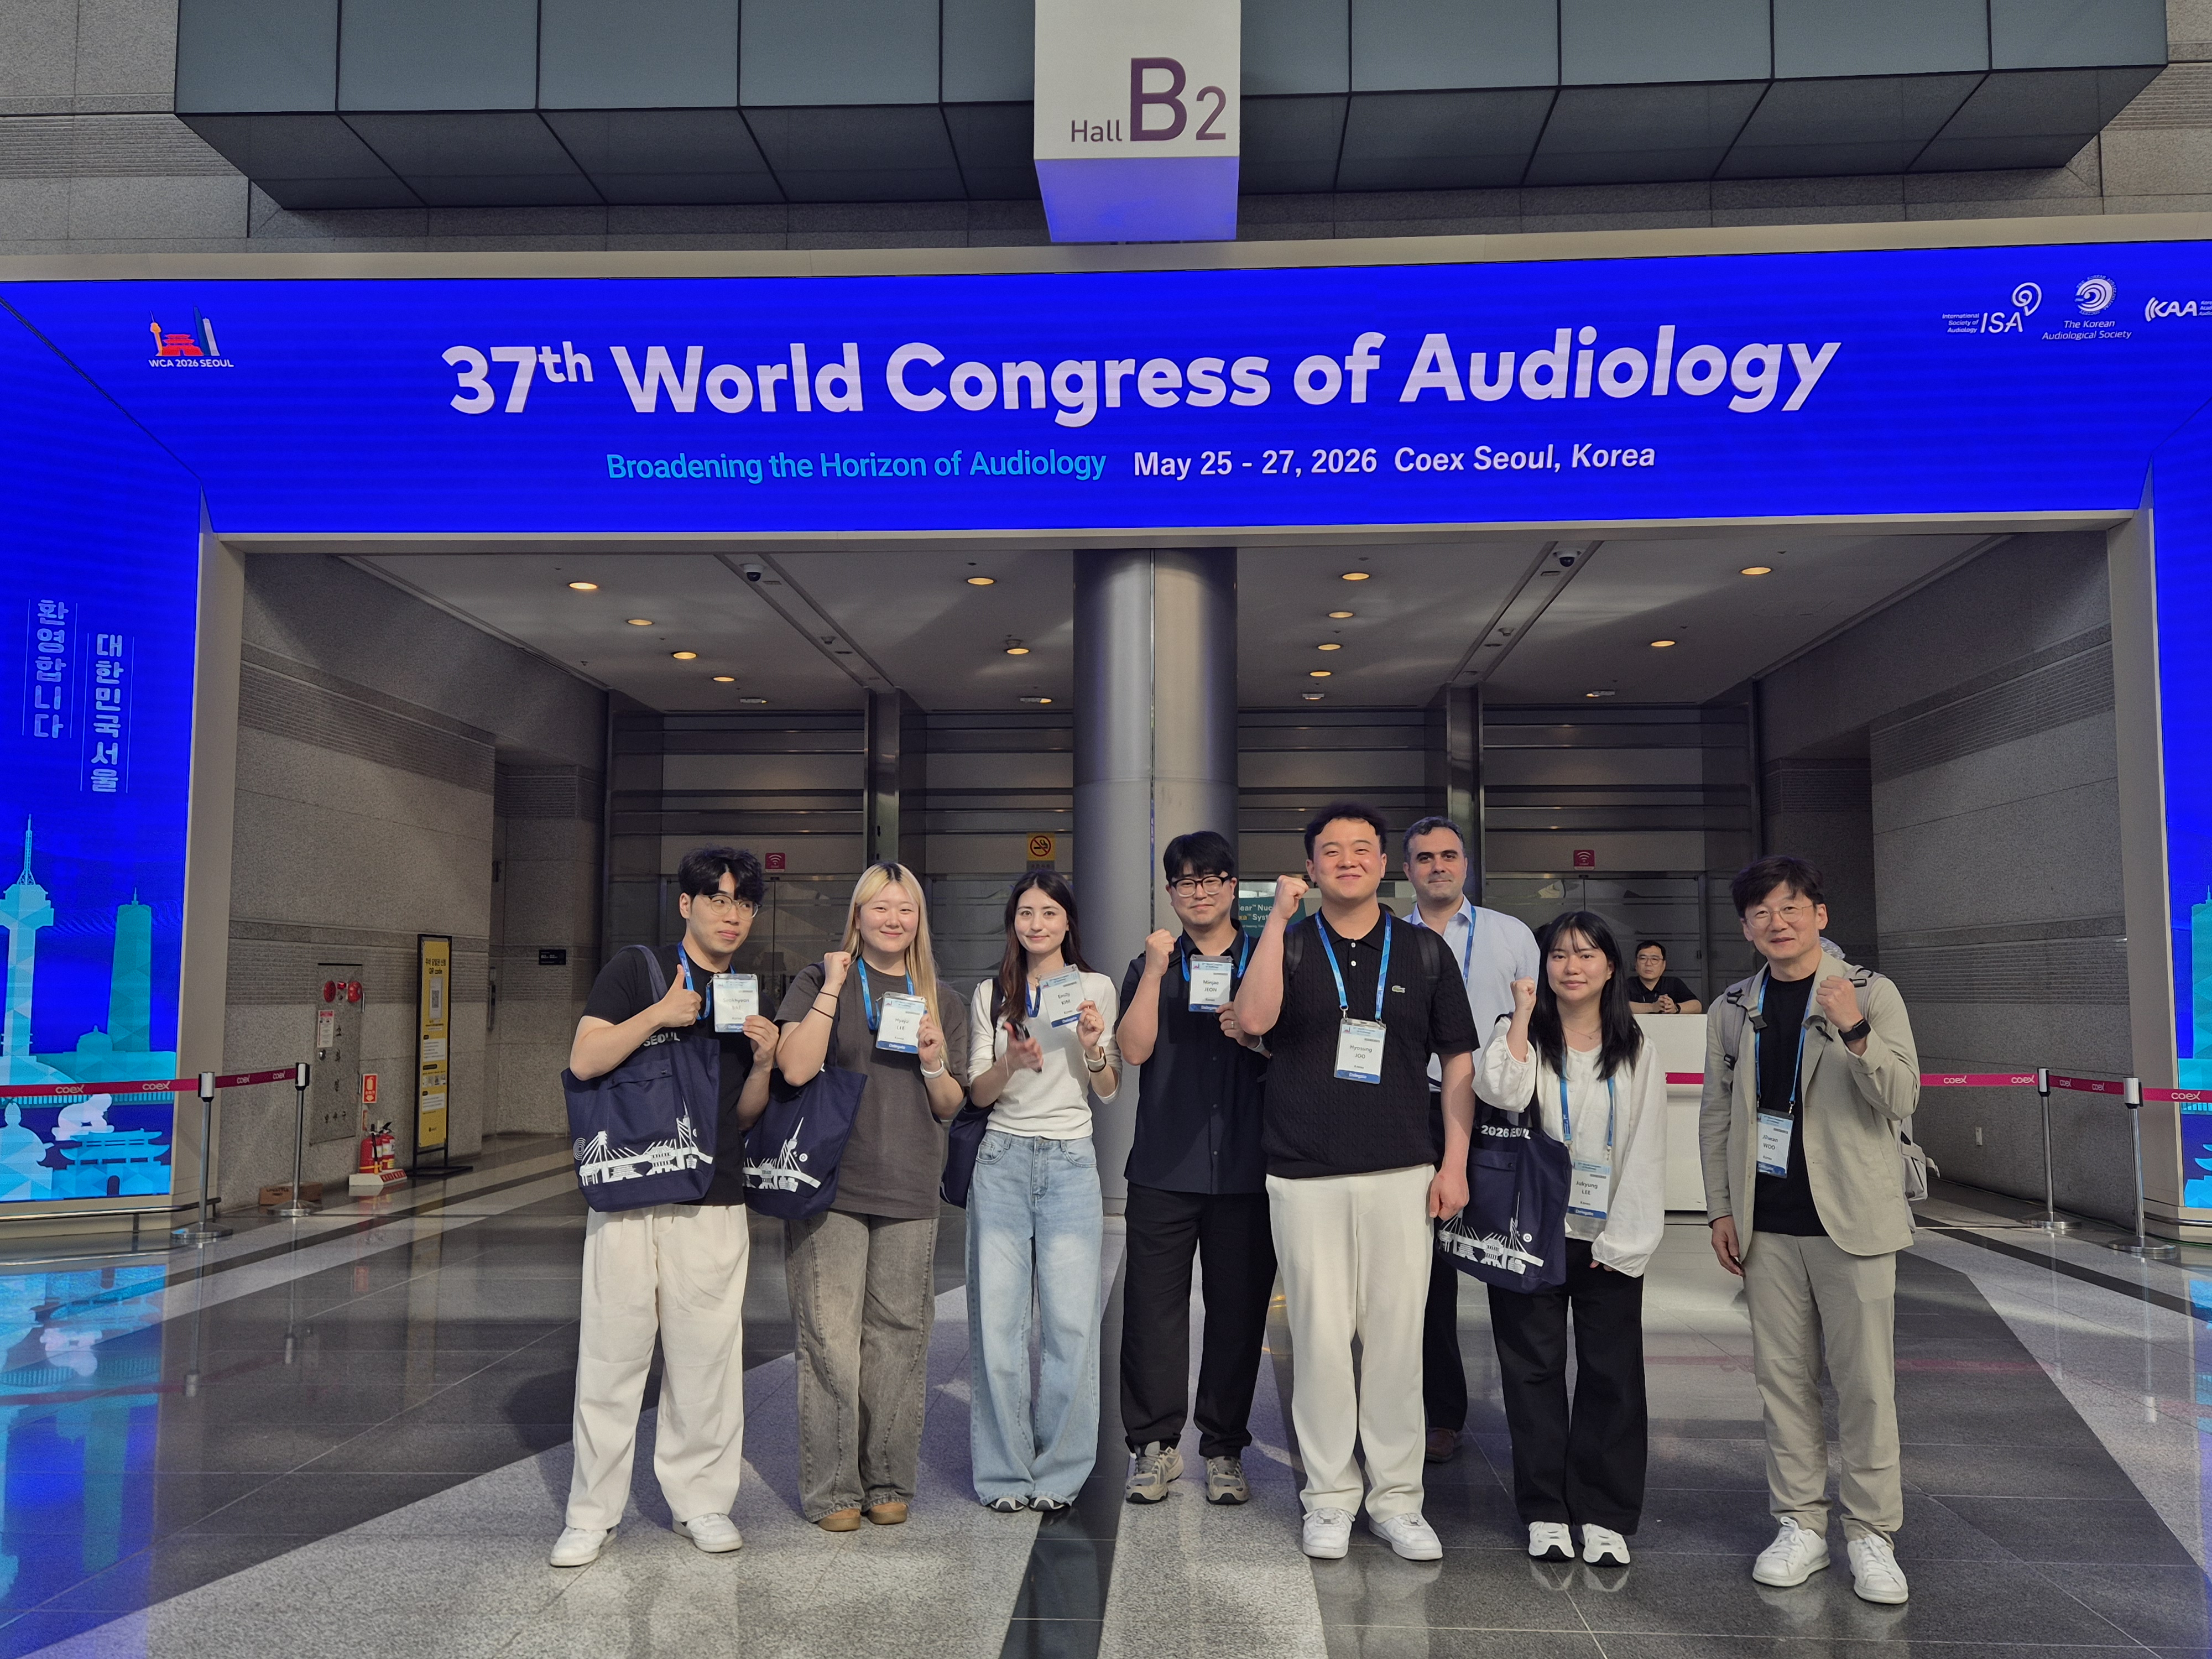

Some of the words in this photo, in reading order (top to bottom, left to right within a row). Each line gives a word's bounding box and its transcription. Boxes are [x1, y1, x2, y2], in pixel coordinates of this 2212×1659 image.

[1071, 119, 1123, 142] Hall
[2154, 301, 2198, 317] KAA
[1980, 311, 2023, 333] ISA
[2064, 320, 2081, 328] The
[2042, 331, 2097, 341] Audiological
[2098, 330, 2132, 339] Society
[200, 359, 234, 368] SEOUL
[441, 341, 593, 414] 37th
[609, 342, 864, 413] World
[886, 342, 1271, 427] Congress
[1293, 332, 1386, 405] of
[1399, 325, 1842, 413] Audiology
[607, 453, 763, 484] Broadening
[769, 452, 813, 478] the
[821, 451, 927, 478] Horizon
[935, 451, 962, 476] of
[970, 448, 1107, 481] Audiology
[1134, 451, 1192, 481] May
[1201, 451, 1233, 475] 25
[1262, 450, 1302, 479] 27,
[1311, 448, 1377, 474] 2026
[1394, 447, 1465, 472] Coex
[1473, 444, 1561, 473] Seoul,
[1571, 443, 1656, 468] Korea
[34, 599, 69, 738] 환영합니다
[643, 1032, 681, 1047] SEOUL
[236, 1074, 251, 1084] coex
[273, 1070, 285, 1080] coex
[1943, 1074, 1968, 1084] coex
[2011, 1074, 2036, 1084] coex
[142, 1081, 171, 1091] coex
[2059, 1078, 2072, 1088] coex
[2092, 1082, 2105, 1092] coex
[55, 1084, 86, 1094] coex
[2171, 1091, 2202, 1101] coex
[1480, 1125, 1510, 1138] 2026
